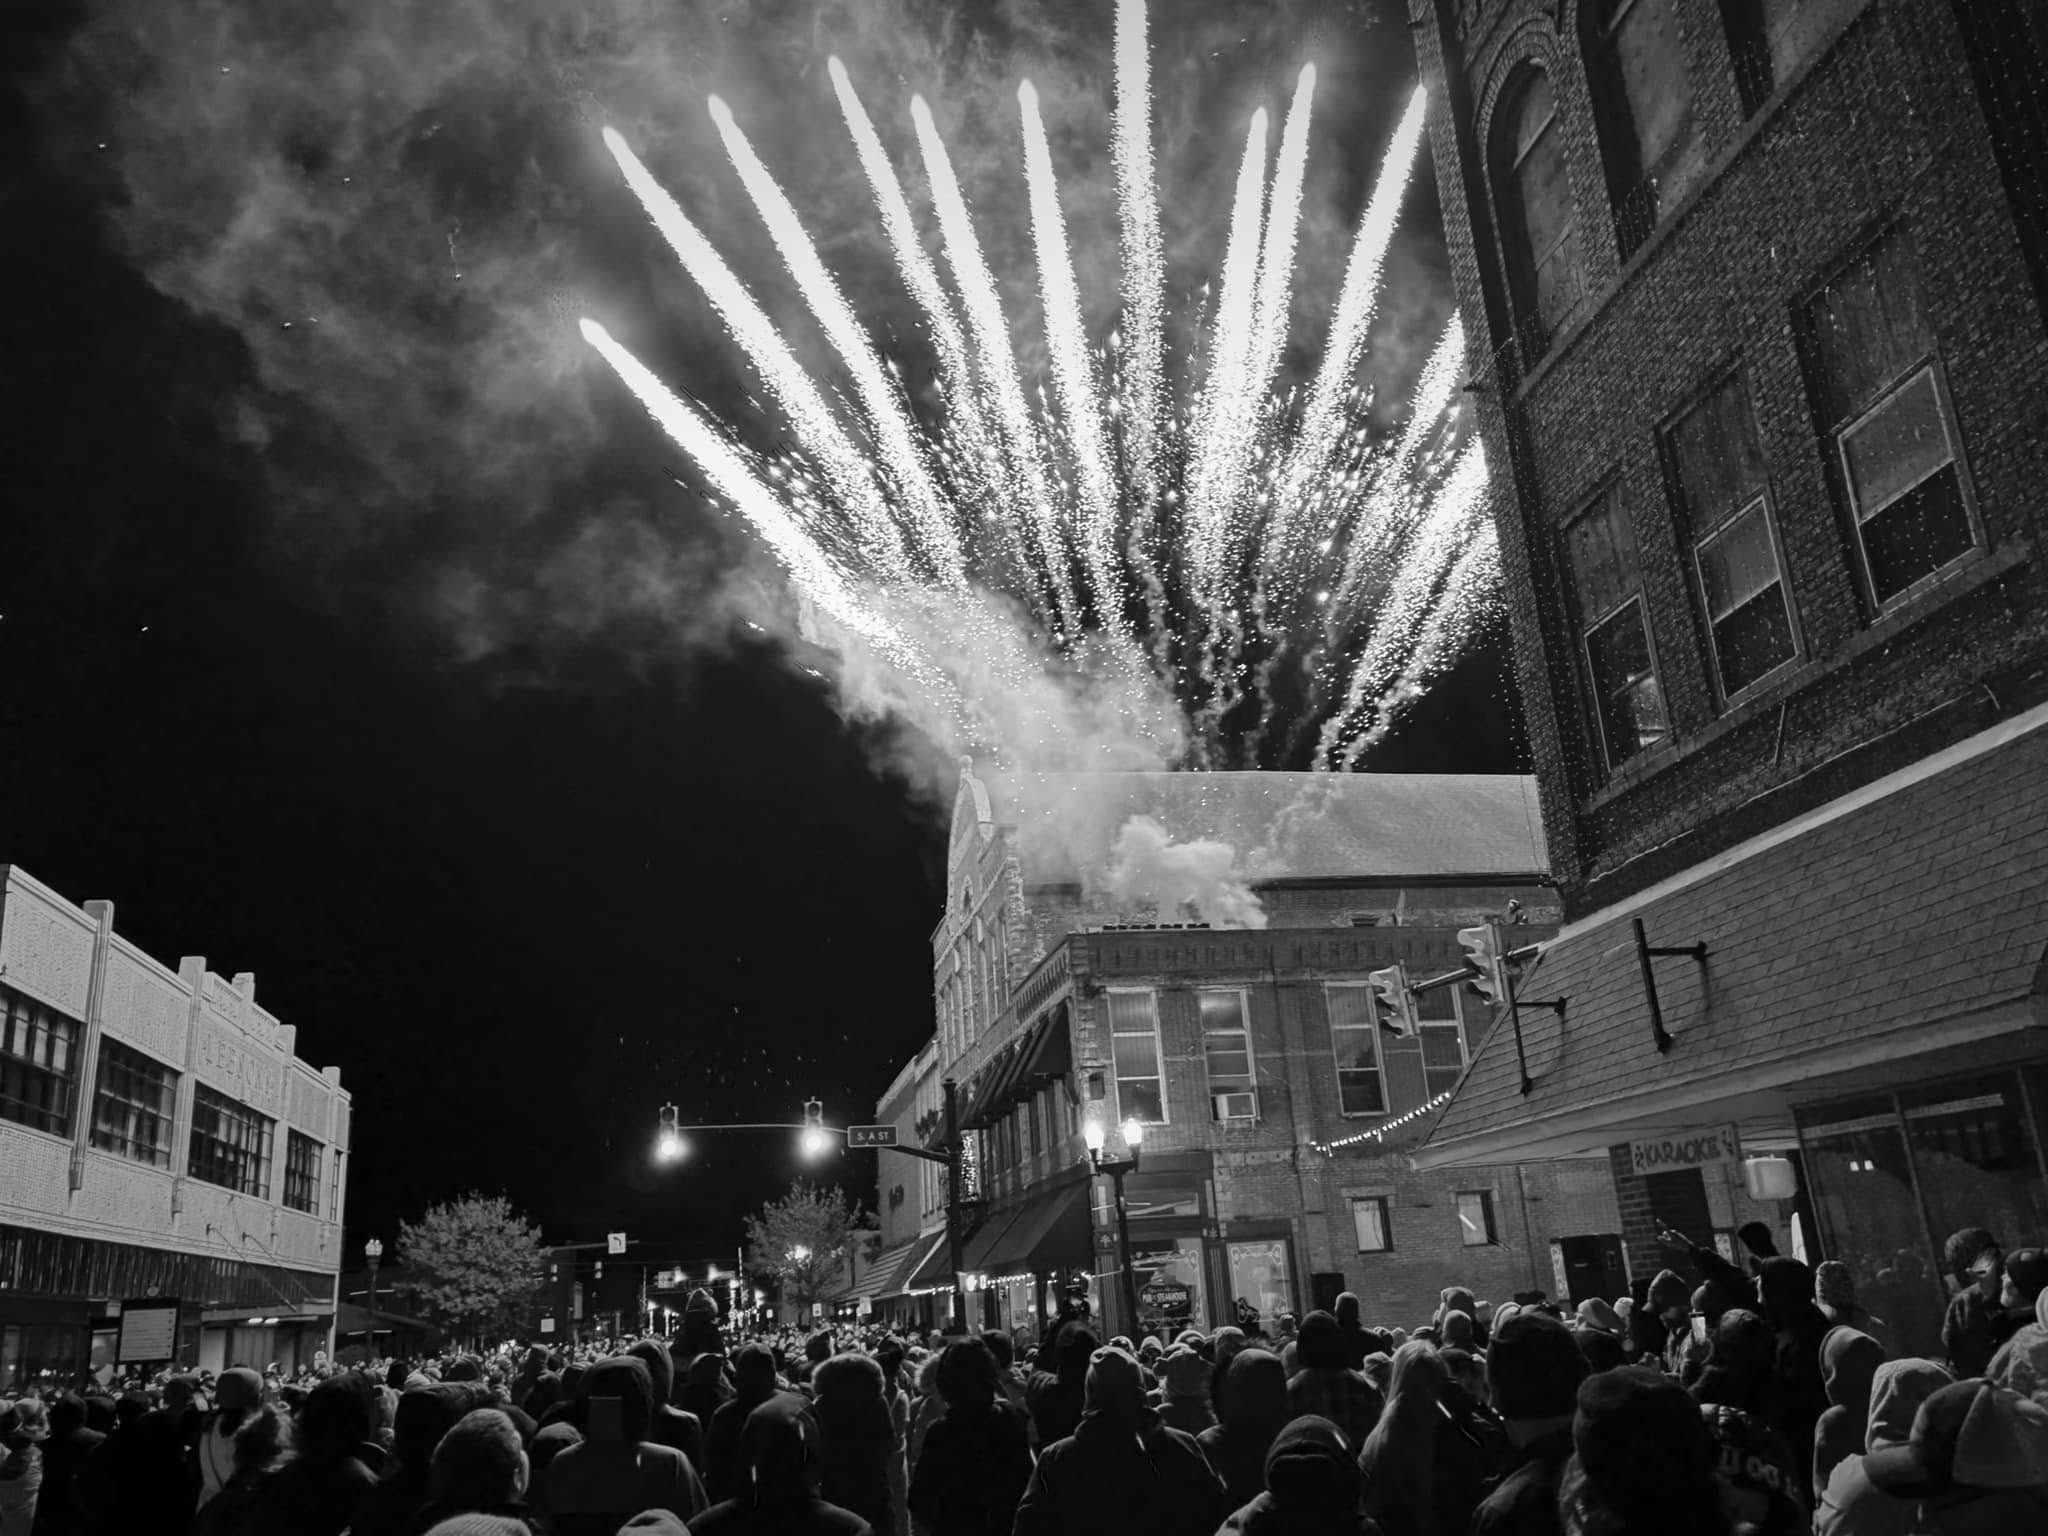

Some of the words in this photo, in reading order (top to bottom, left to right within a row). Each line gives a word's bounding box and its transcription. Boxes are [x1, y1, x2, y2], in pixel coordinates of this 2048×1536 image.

[868, 1131, 876, 1140] A
[878, 1131, 889, 1140] ST
[1645, 1136, 1720, 1166] KARAOKE
